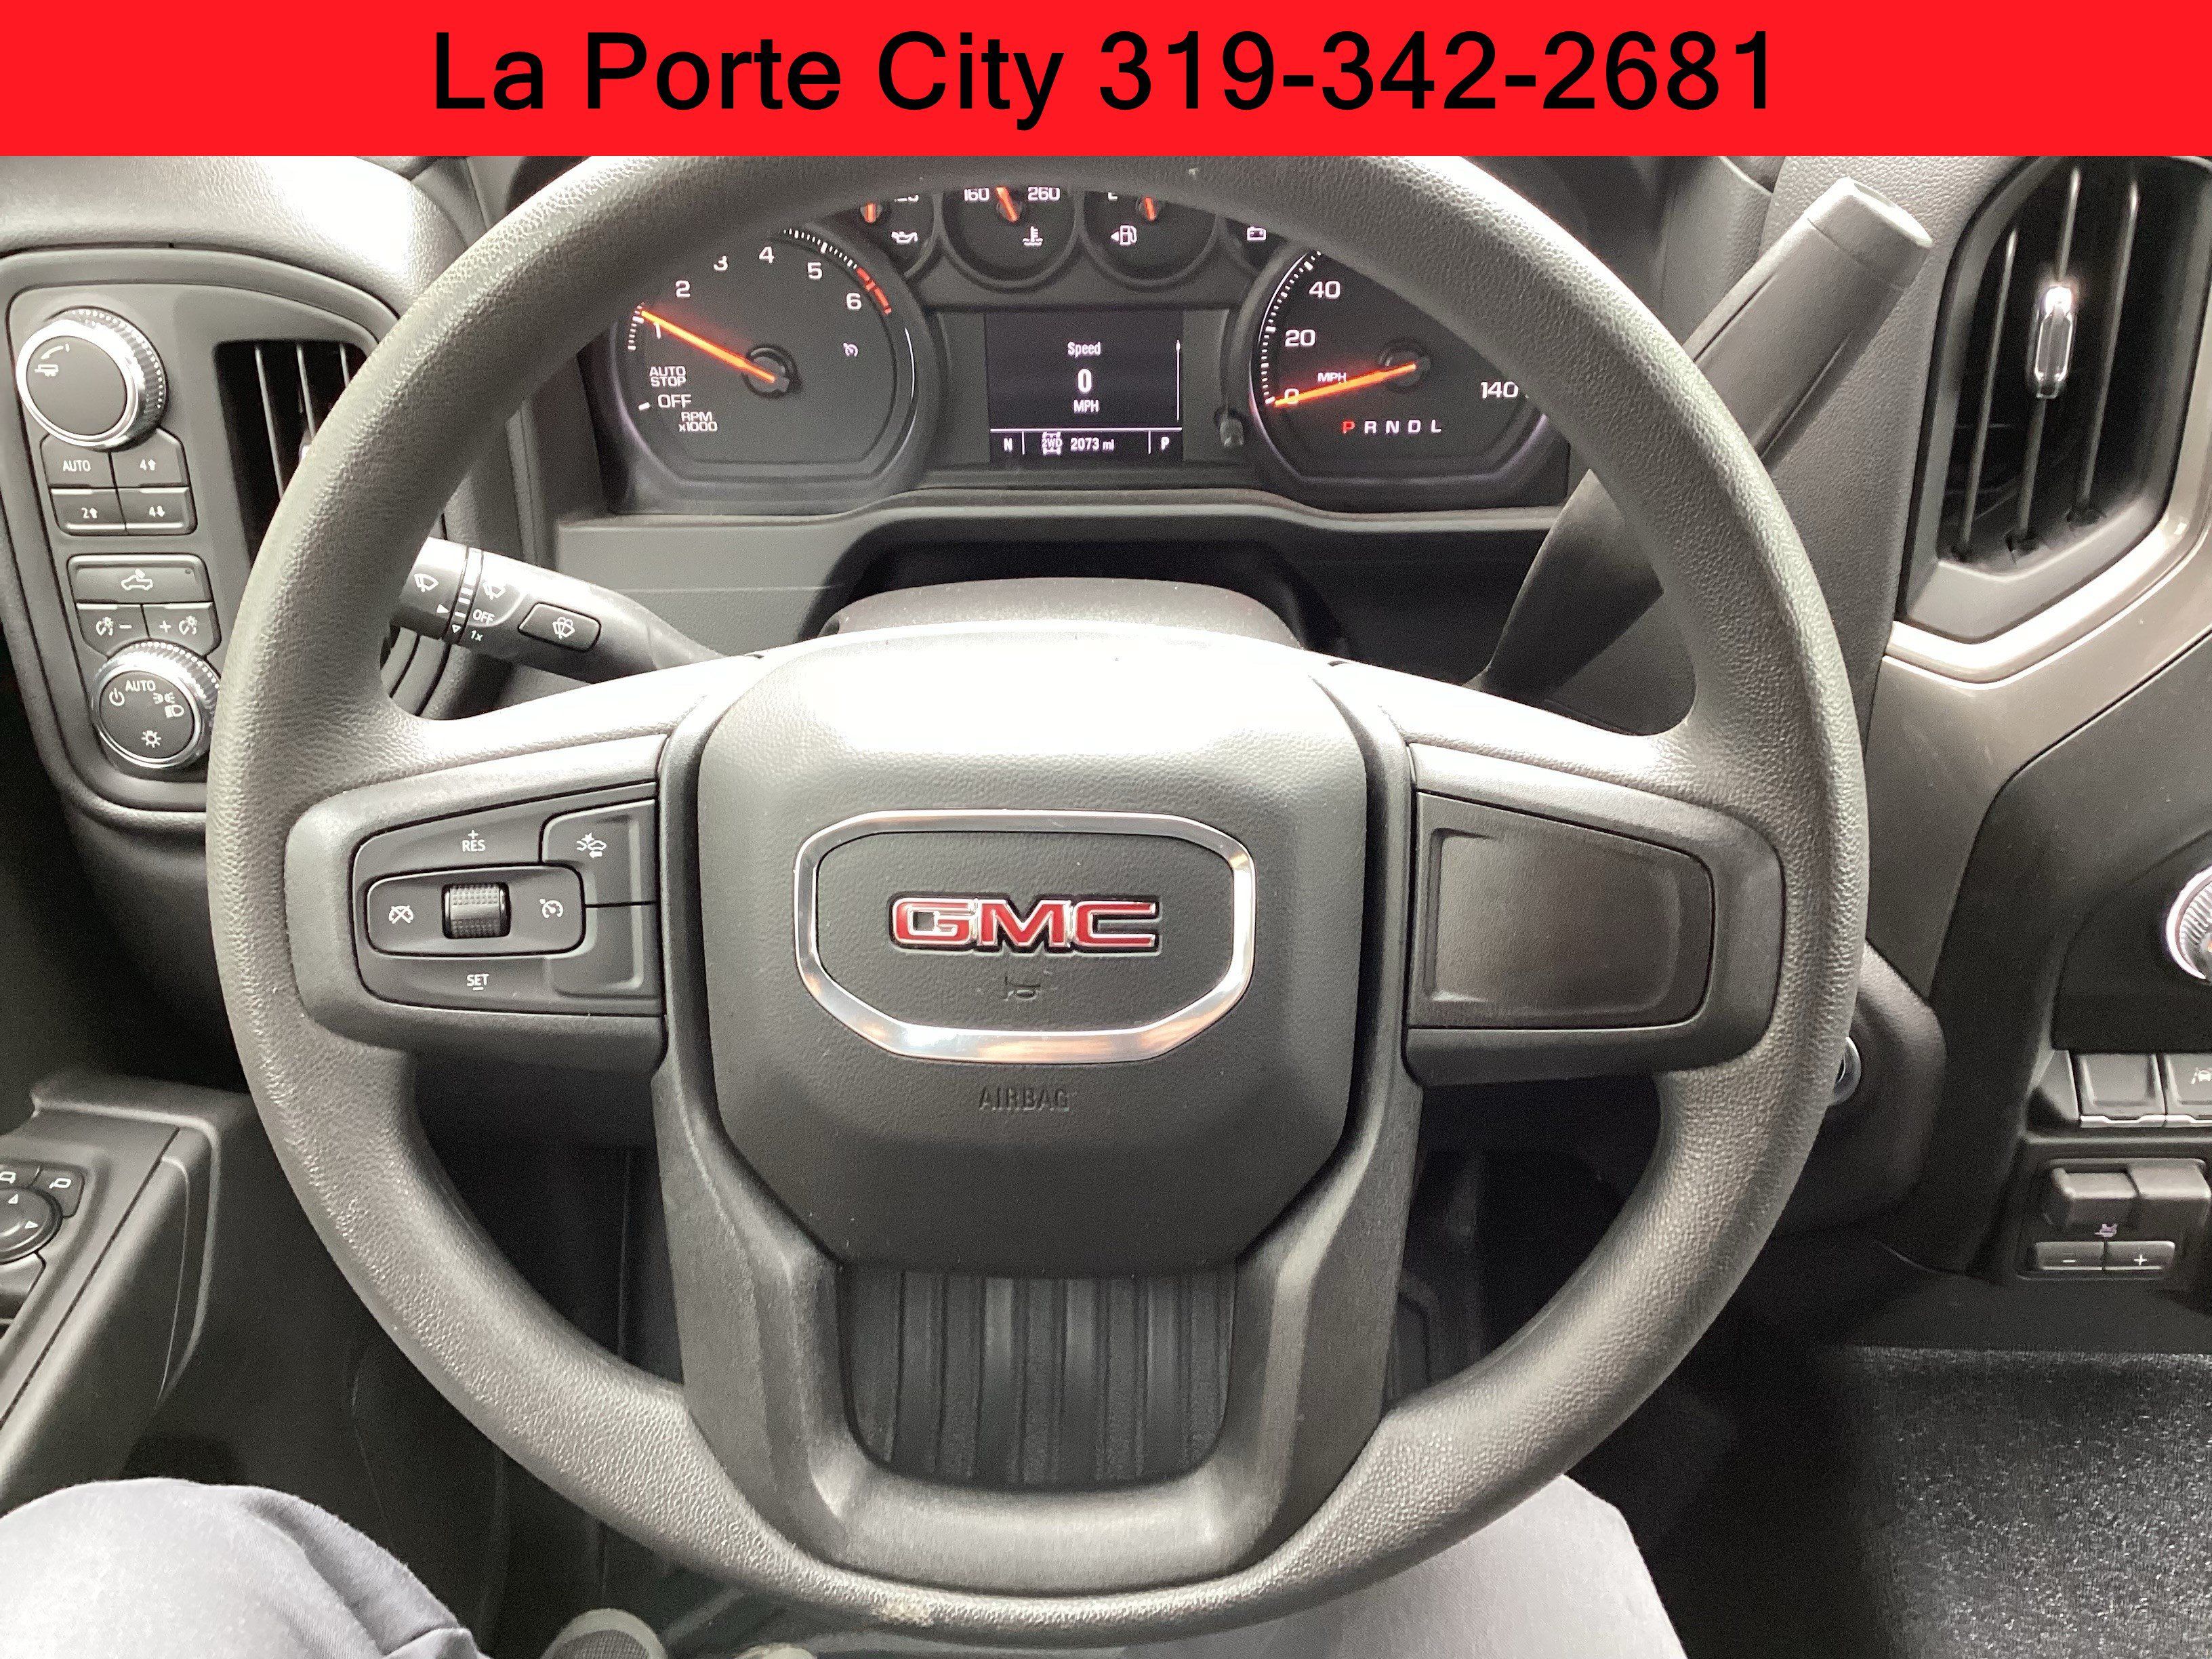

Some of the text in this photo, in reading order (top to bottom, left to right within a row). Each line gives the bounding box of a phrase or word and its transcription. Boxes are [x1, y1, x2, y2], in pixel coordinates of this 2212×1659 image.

[964, 188, 989, 201] 160
[1027, 186, 1061, 201] 260
[759, 247, 774, 263] 4
[714, 255, 728, 271] 3
[807, 262, 823, 279] 5
[676, 281, 691, 298] 2
[1309, 281, 1341, 299] 40
[846, 293, 861, 310] 6
[1285, 329, 1316, 346] 20
[1067, 342, 1101, 357] Speed
[649, 367, 686, 377] AUTO
[1317, 372, 1347, 384] MPH
[651, 377, 686, 387] STOP
[1078, 368, 1092, 393] 0
[1481, 382, 1519, 398] 140
[657, 394, 691, 408] OFF
[1073, 399, 1099, 413] MPH
[681, 411, 713, 422] RPM
[1342, 420, 1441, 434] P R N D L
[1004, 438, 1012, 452] N
[1070, 437, 1115, 451] 2073 mi
[1161, 436, 1170, 451] P
[62, 460, 91, 472] AUTO
[472, 609, 495, 624] OFF
[125, 680, 157, 692] AUTO
[462, 839, 486, 852] RES
[890, 896, 1158, 949] GMC
[466, 974, 489, 985] SET
[979, 1086, 1071, 1112] AIRBAG
